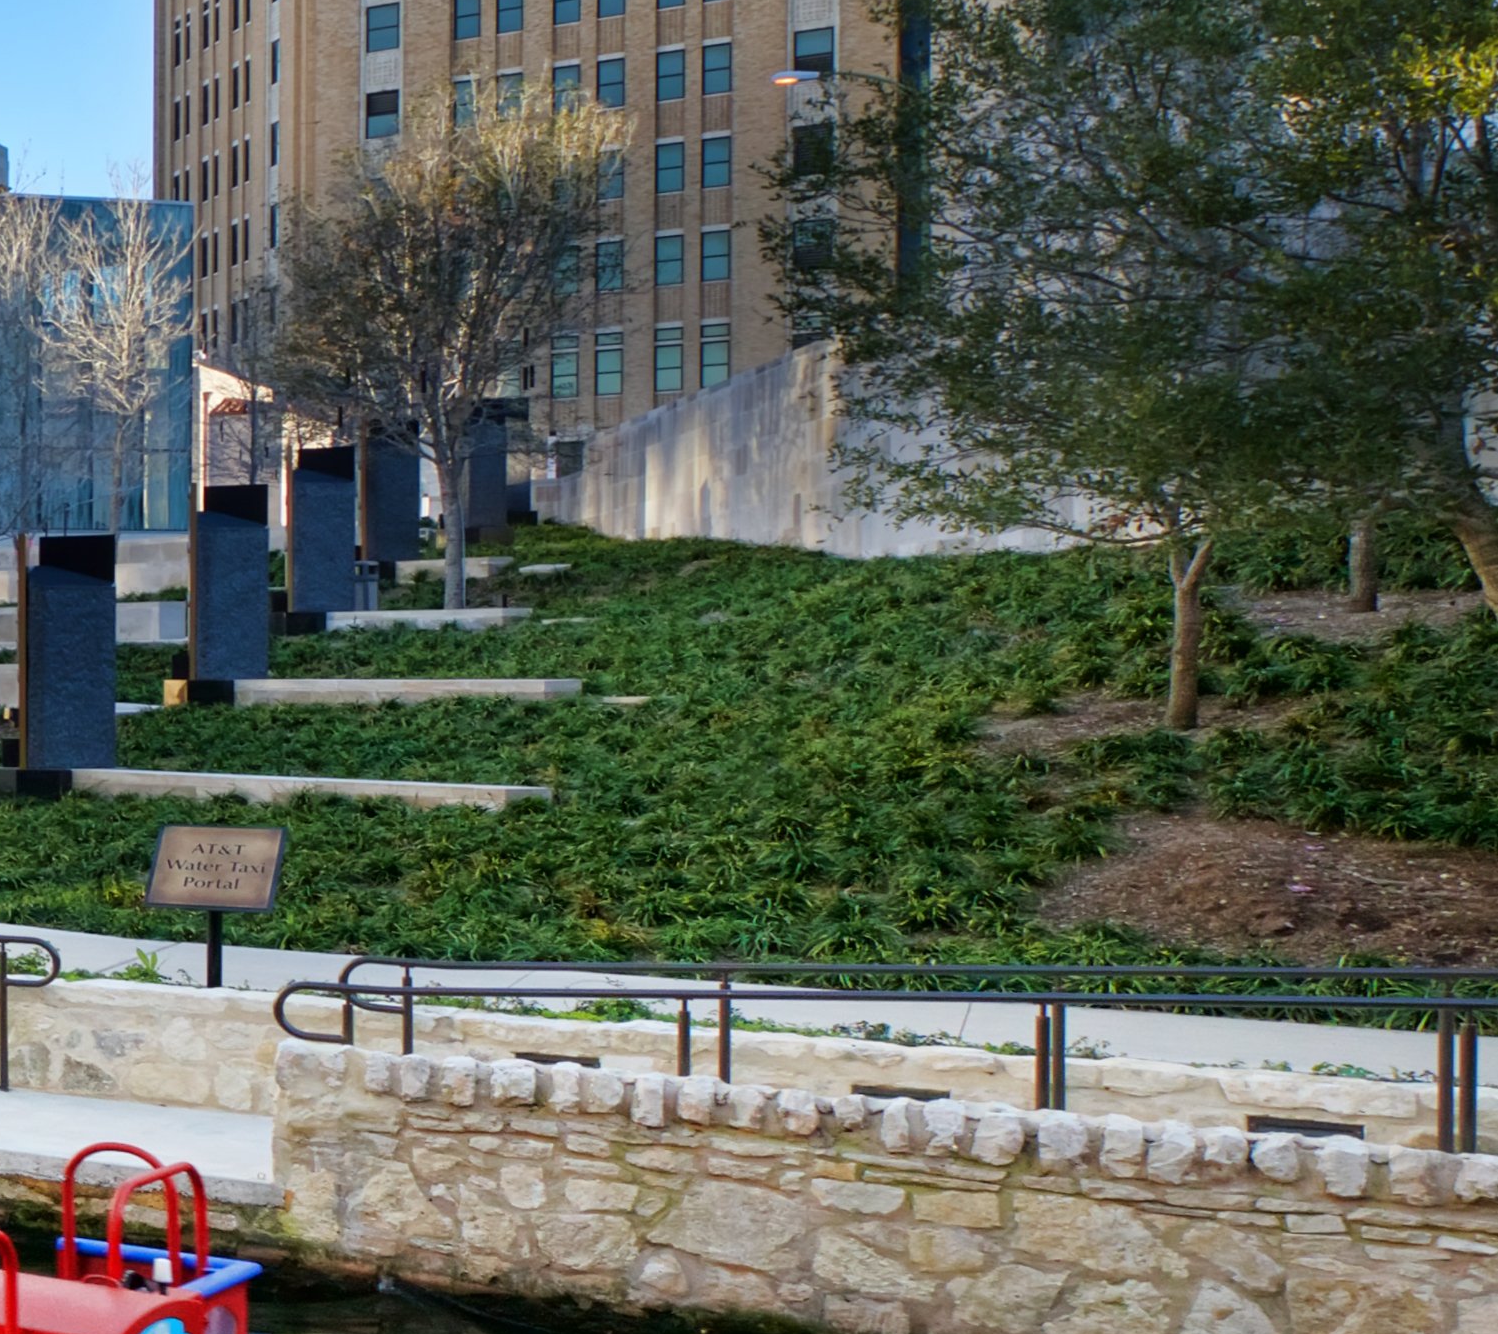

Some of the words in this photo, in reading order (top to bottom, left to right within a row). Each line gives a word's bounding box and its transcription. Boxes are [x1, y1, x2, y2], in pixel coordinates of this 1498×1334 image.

[191, 843, 246, 856] AT&T
[167, 858, 223, 873] Water
[230, 861, 266, 874] Taxi
[183, 876, 240, 890] Portal
